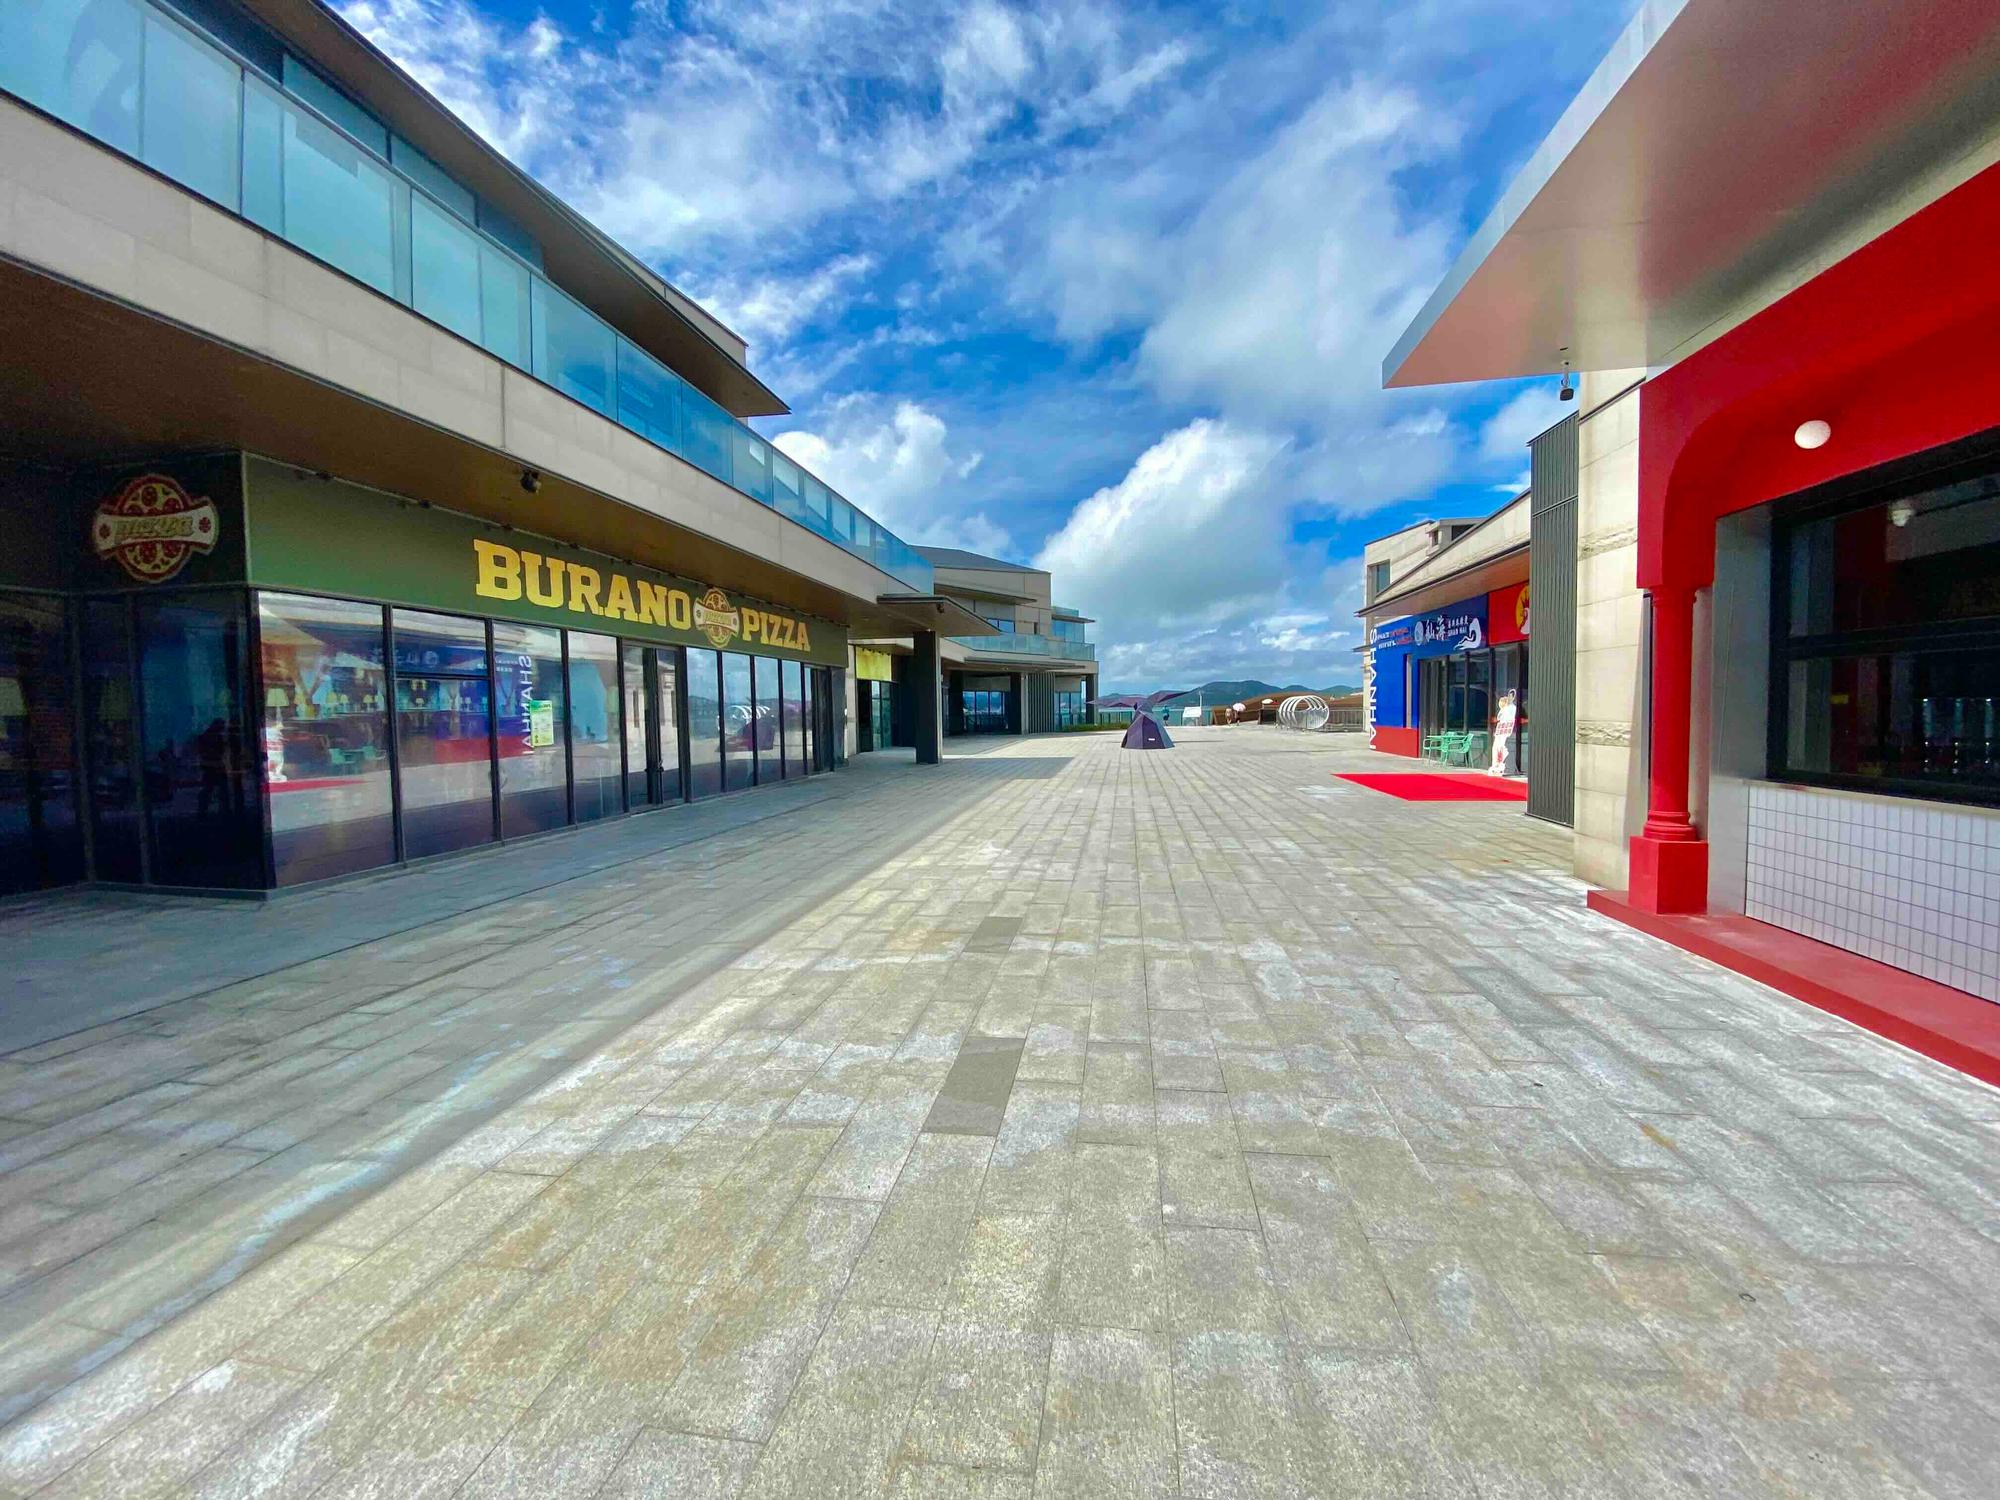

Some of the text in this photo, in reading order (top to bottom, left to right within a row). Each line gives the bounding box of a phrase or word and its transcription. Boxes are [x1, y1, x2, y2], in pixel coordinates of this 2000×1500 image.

[474, 538, 811, 652] BURANO PIZZA
[1369, 628, 1377, 750] SHANHAI
